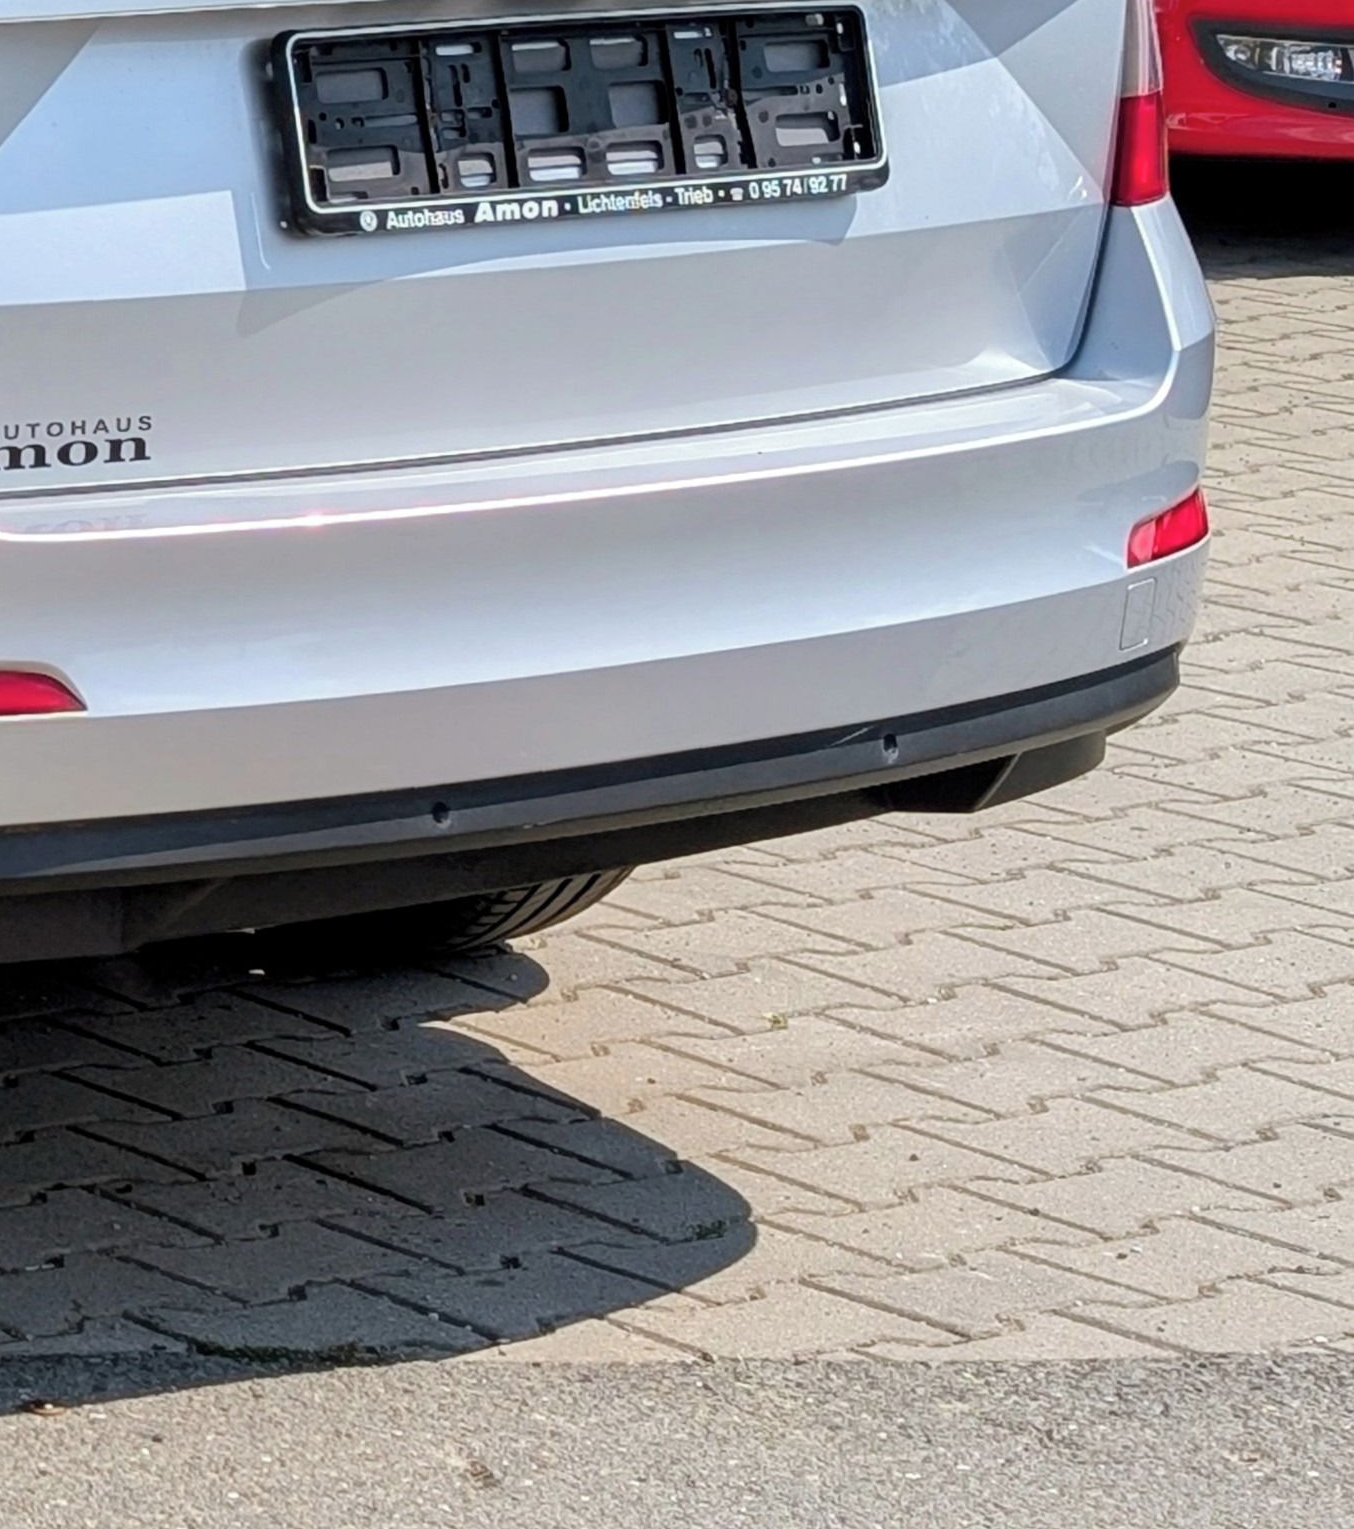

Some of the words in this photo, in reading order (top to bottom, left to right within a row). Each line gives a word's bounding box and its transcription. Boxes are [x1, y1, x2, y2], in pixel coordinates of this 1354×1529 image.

[386, 207, 465, 230] Autohaus
[473, 199, 559, 223] Amon
[577, 190, 664, 214] Lichtenfels
[674, 186, 714, 206] Trieb
